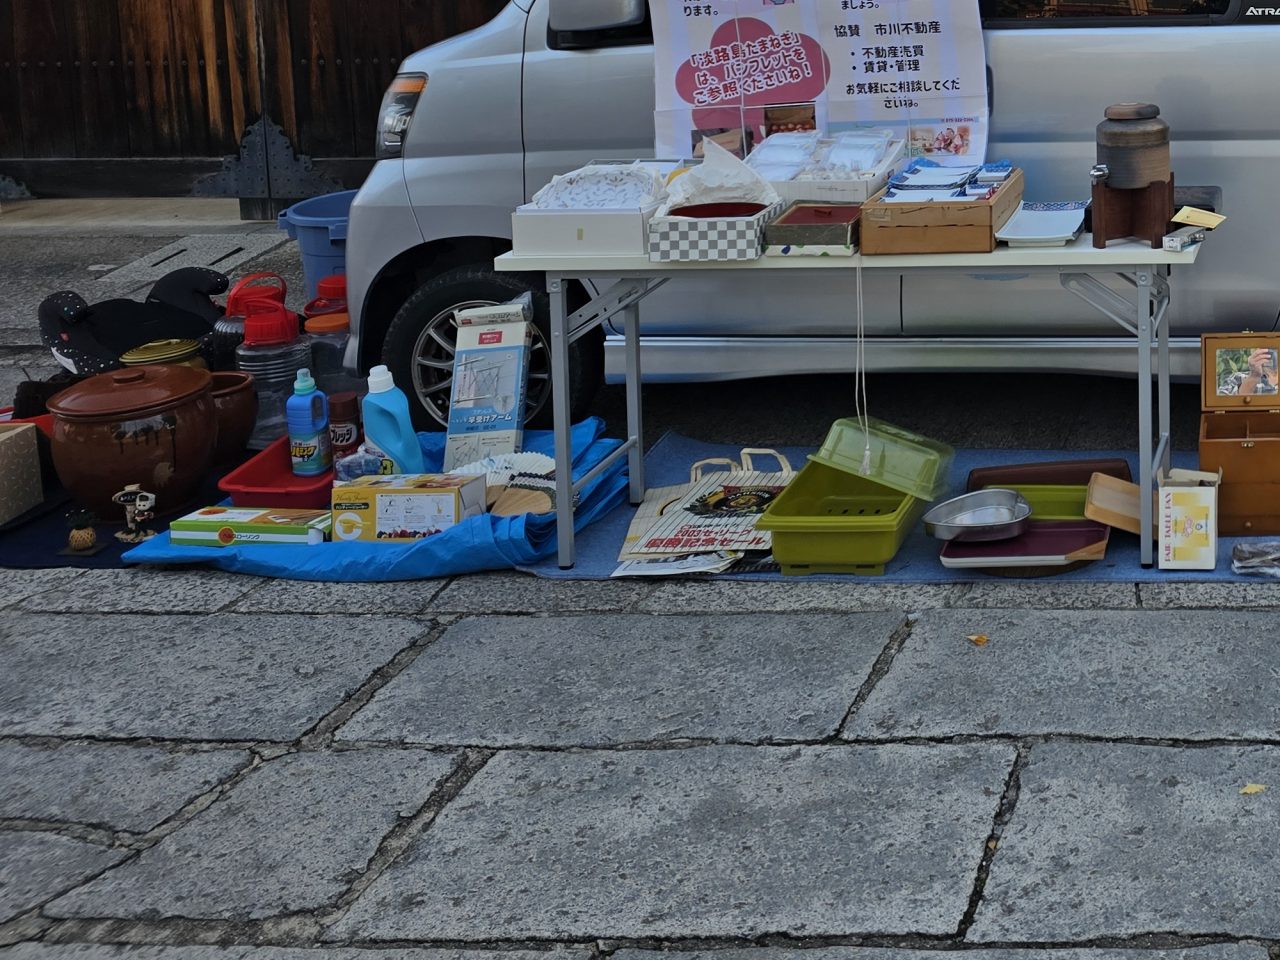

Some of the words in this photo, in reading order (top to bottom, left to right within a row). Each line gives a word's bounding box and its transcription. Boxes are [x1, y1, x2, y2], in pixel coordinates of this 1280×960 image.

[683, 4, 719, 17] ります。
[874, 20, 942, 36] 市川不動産
